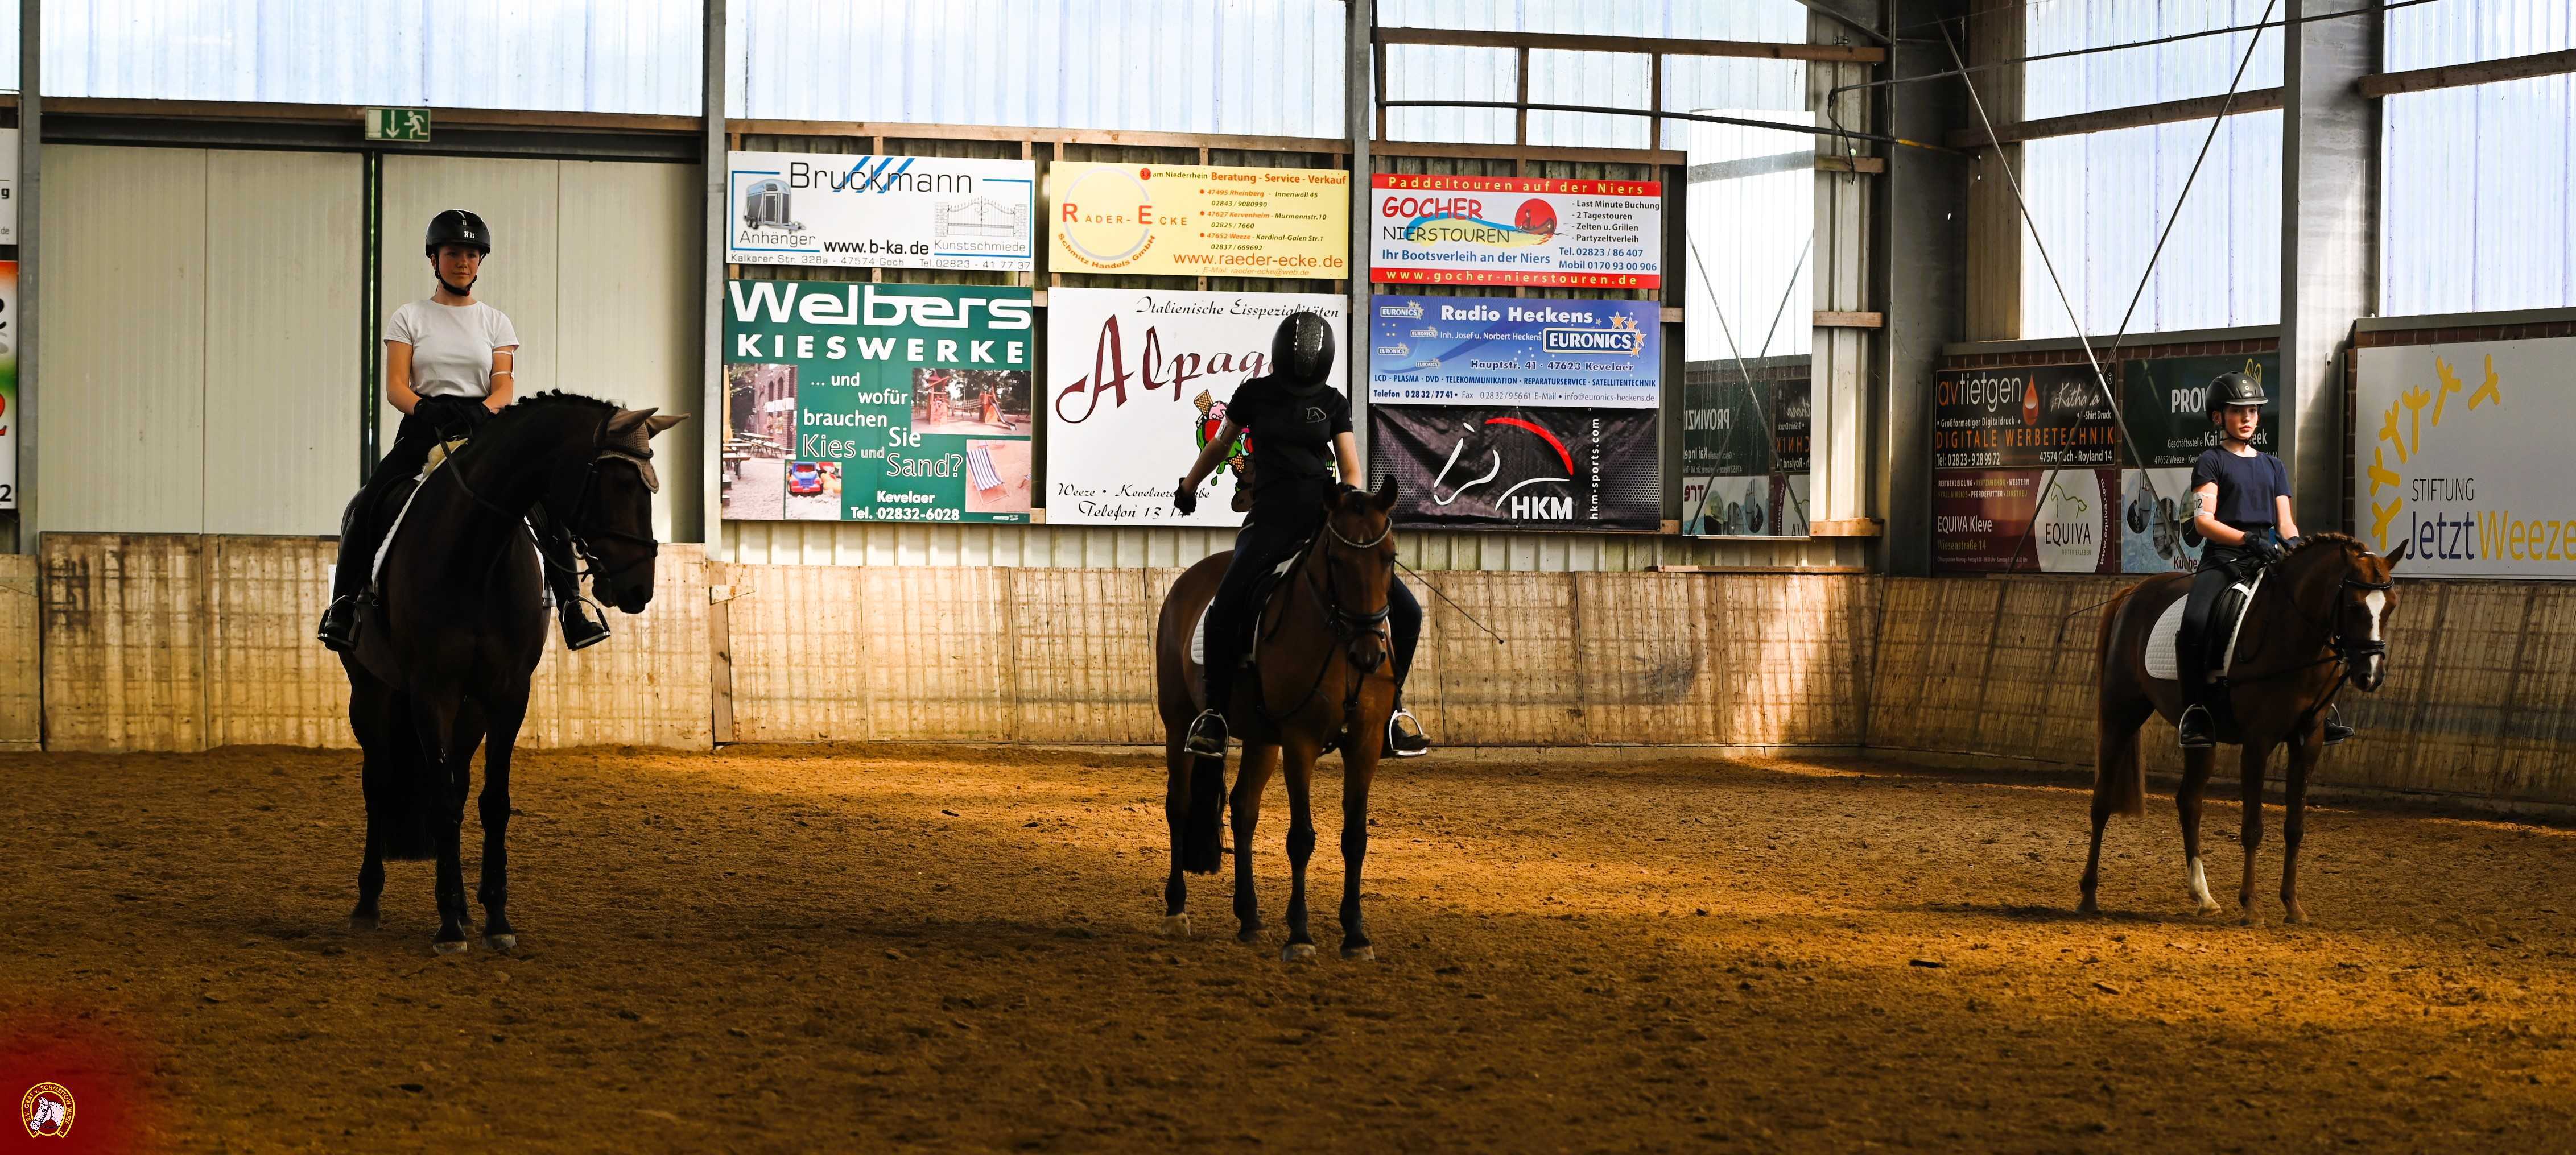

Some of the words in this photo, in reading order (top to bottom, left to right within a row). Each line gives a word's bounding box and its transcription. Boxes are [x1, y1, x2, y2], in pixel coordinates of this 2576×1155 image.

[790, 162, 972, 193] Bruckmann
[1212, 172, 1256, 184] Beratung
[1265, 173, 1300, 183] Service
[1308, 175, 1346, 184] Verkauf
[1389, 177, 1512, 191] Paddeltouren
[1523, 180, 1550, 192] auf
[1560, 181, 1588, 193] der
[1598, 184, 1643, 194] Niers
[1382, 197, 1483, 220] GOCHER
[1595, 201, 1623, 209] Minute
[1625, 201, 1660, 211] Buchung
[1583, 212, 1632, 221] Tagestouren
[1383, 226, 1509, 243] NIERSTOUREN
[1612, 223, 1638, 232] Grillen
[740, 230, 816, 248] Anhänger
[824, 239, 929, 255] www.b-ka.de
[935, 239, 1026, 252] Kunstschmiede
[1576, 234, 1639, 244] Partyzeltverleih
[1058, 233, 1089, 264] Schmitz
[1132, 235, 1155, 261] GmbH
[1382, 249, 1399, 260] Ihr
[1402, 250, 1477, 263] Bootsverleih
[1480, 253, 1495, 262] an
[1498, 252, 1517, 263] der
[1520, 253, 1550, 264] Niers
[1576, 247, 1605, 257] 02823
[1613, 248, 1624, 257] 86
[1626, 249, 1643, 258] 407
[730, 254, 773, 263] Kalkarer
[778, 255, 796, 263] Str.
[841, 256, 874, 266] 47574
[879, 257, 904, 266] Goch
[1173, 253, 1343, 268] www.raeder-ecke.de
[1559, 260, 1585, 270] Mobil
[1588, 260, 1611, 270] 0170
[1613, 262, 1624, 271] 93
[1626, 262, 1637, 271] 00
[1640, 262, 1657, 271] 906
[1386, 270, 1636, 285] www.gocher-nierstouren.de
[728, 281, 1032, 330] Welbers
[1136, 296, 1224, 314] Italienische
[1440, 305, 1501, 322] Radio
[1508, 307, 1593, 324] Heckens
[737, 334, 1023, 364] KIESWERKE
[1549, 332, 1632, 349] EURONICS
[1056, 314, 1264, 423] Alpag
[1471, 359, 1520, 370] Hauptstr.
[1586, 362, 1634, 371] Kevelaer
[831, 372, 860, 387] und
[858, 388, 908, 405] wofür
[1564, 393, 1654, 401] info@euronics-heckens.de
[804, 408, 887, 428] brauchen
[1941, 418, 1980, 429] Großformatiger
[1982, 416, 2014, 428] Digitaldruck
[2098, 410, 2111, 419] Druck
[889, 427, 921, 448] Sie
[1937, 429, 1997, 449] DIGITALE
[2168, 438, 2203, 448] Geschäftsstelle
[2204, 432, 2218, 446] Kai
[803, 434, 856, 458] Kies
[861, 446, 885, 459] und
[887, 453, 962, 478] Sand?
[1937, 454, 1946, 467] Tel:
[2040, 452, 2057, 462] 47574
[2078, 449, 2103, 464] Royland
[2105, 450, 2112, 461] 14
[2154, 456, 2169, 465] 47652
[2169, 456, 2184, 464] Weeze
[1590, 418, 1599, 520] hkm-sports.com
[877, 490, 935, 504] Kevelaer
[1058, 483, 1095, 496] Weeze
[2412, 478, 2474, 502] STIFTUNG
[851, 507, 873, 520] Tel.
[877, 507, 960, 520] 02832-6028
[1079, 501, 1136, 521] Telefon
[1145, 507, 1162, 519] 13
[1511, 496, 1572, 520] HKM
[1938, 516, 1968, 534] EQUIVA
[1970, 515, 1992, 532] Kleve
[2045, 523, 2091, 547] EQUIVA
[1938, 539, 1977, 550] Wiesenstraße
[1979, 540, 1985, 550] 14
